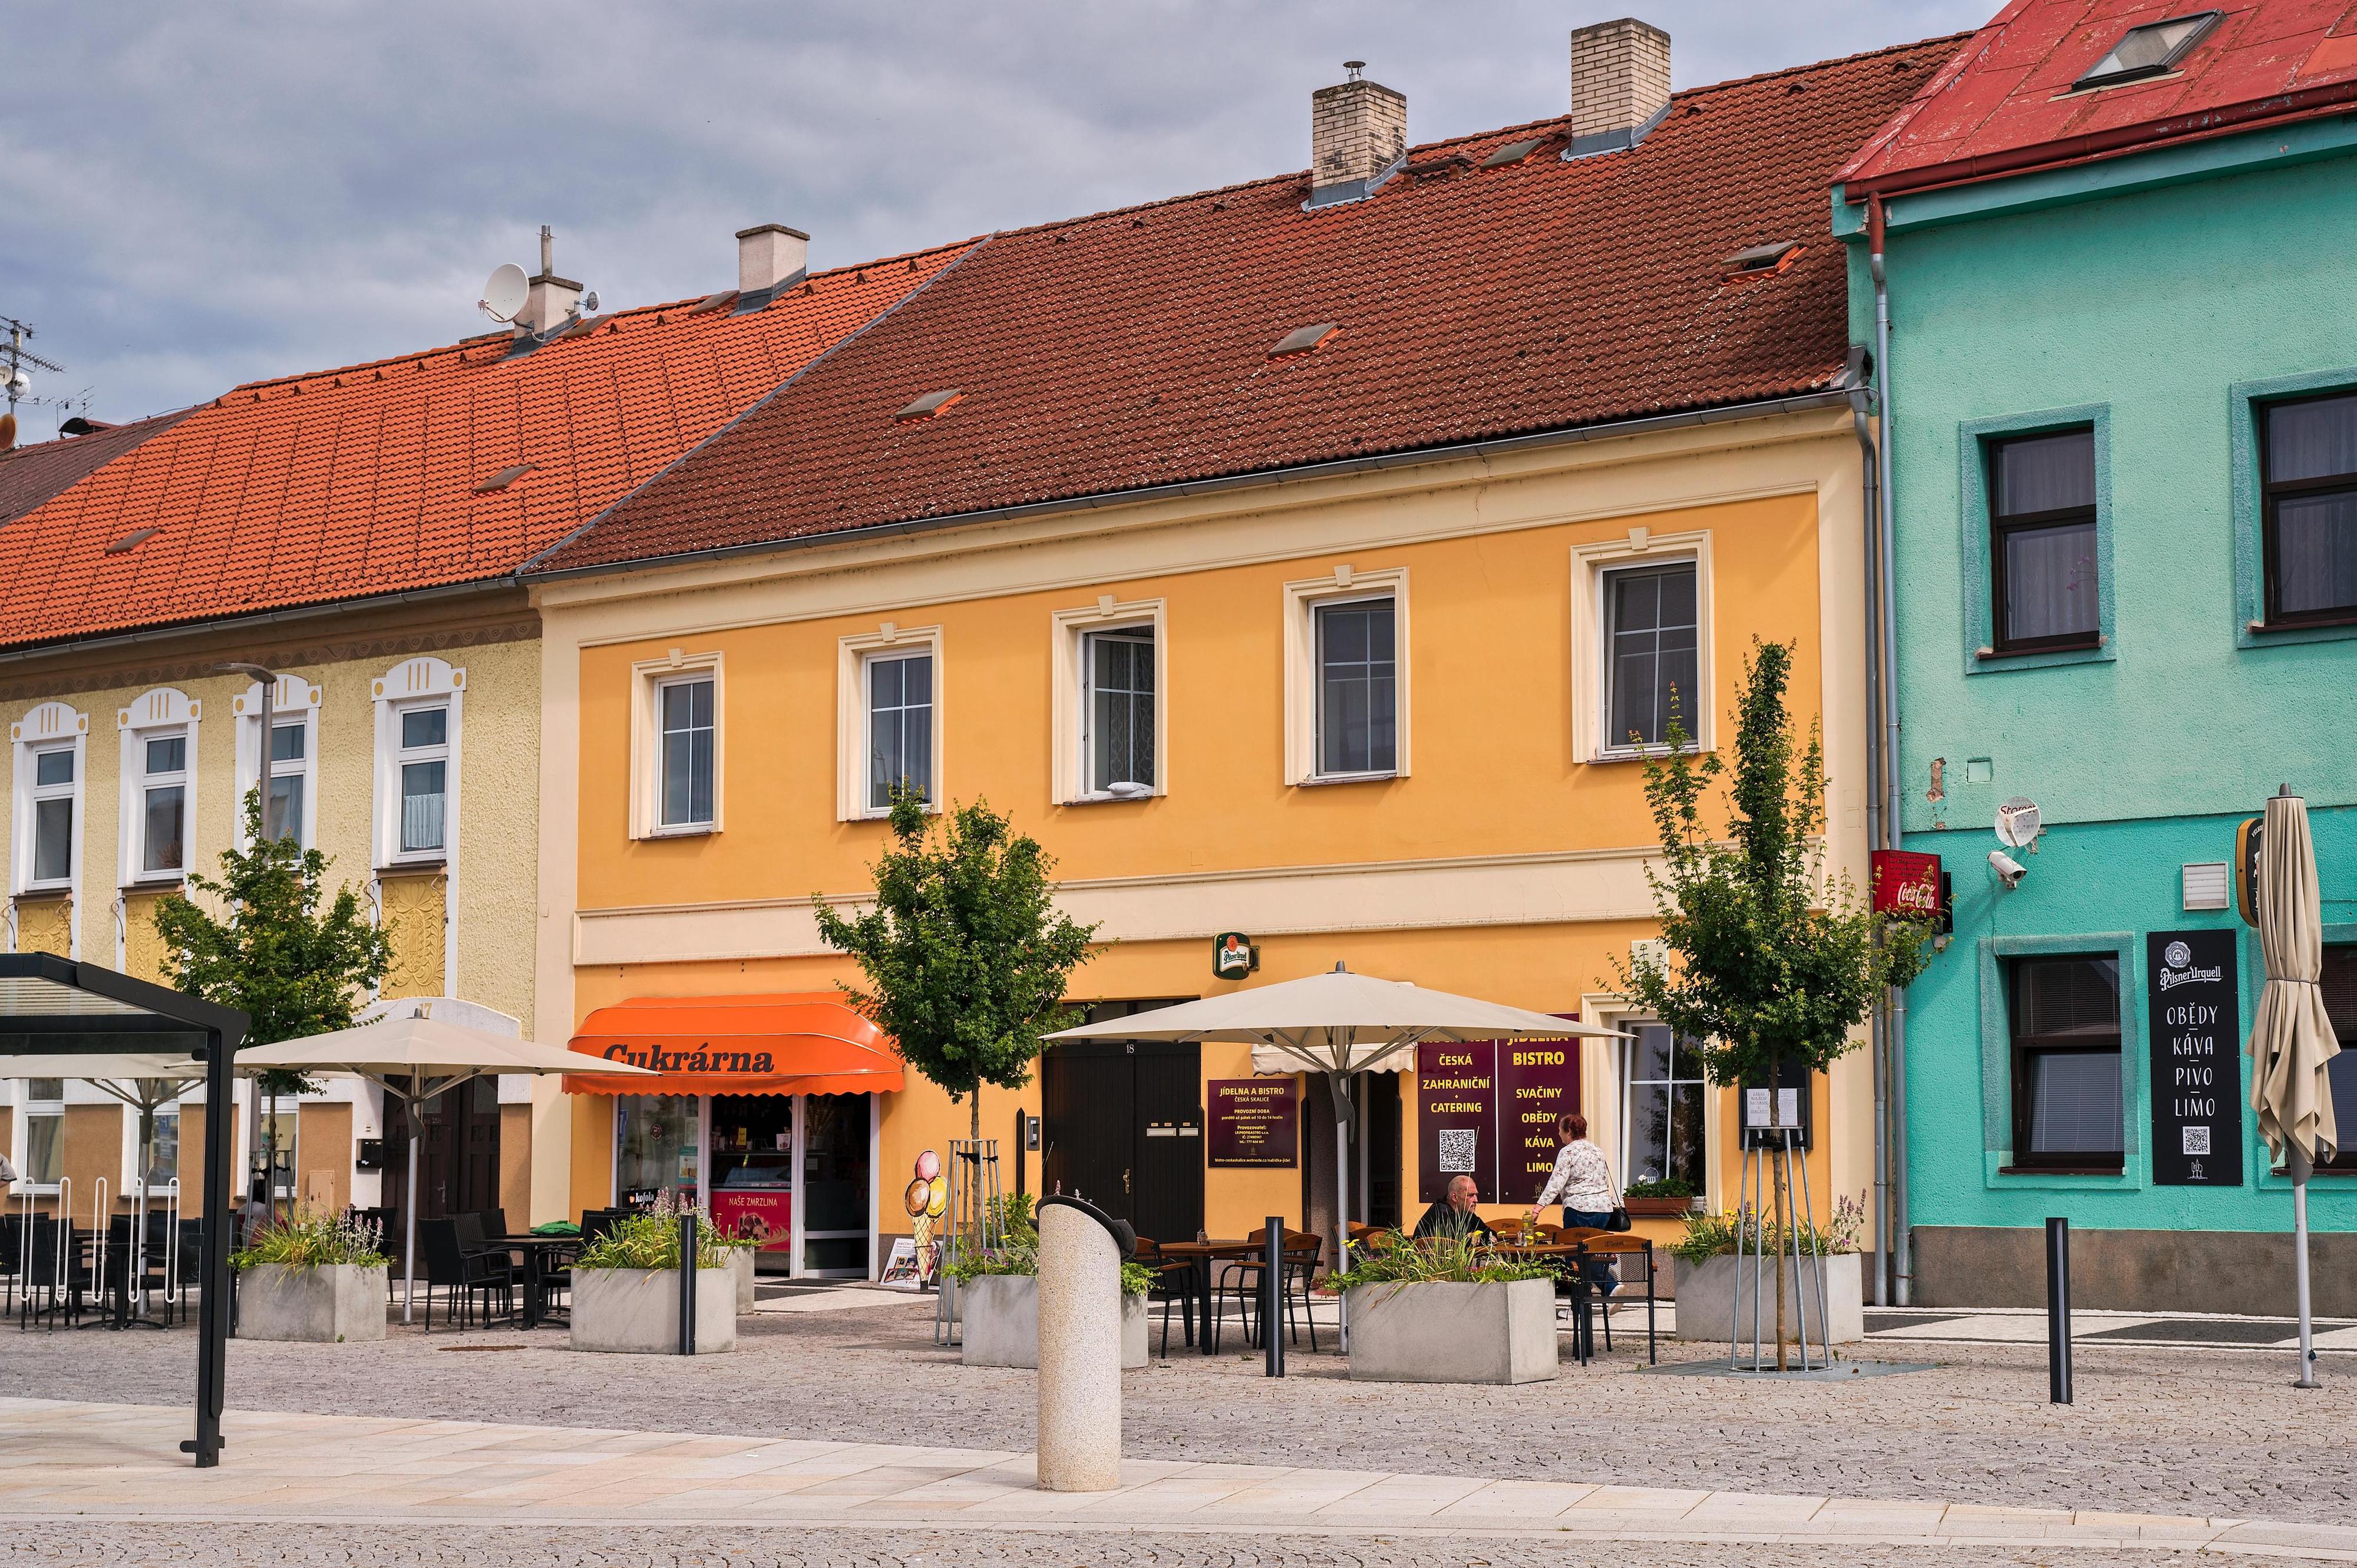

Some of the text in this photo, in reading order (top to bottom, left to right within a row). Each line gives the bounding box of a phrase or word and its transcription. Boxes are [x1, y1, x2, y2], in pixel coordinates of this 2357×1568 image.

[2160, 966, 2221, 991] Pilsner Urquell
[2167, 1002, 2218, 1025] OBĚDY
[1126, 1044, 1134, 1054] 18
[2173, 1032, 2213, 1055] KÁVA
[603, 1042, 775, 1073] Cukrárna
[1439, 1052, 1473, 1066] ČESKÁ
[1513, 1051, 1565, 1066] BISTRO
[1422, 1076, 1491, 1090] ZAHRANIČNÍ
[2176, 1067, 2213, 1086] PIVO
[1219, 1086, 1249, 1097] JÍDELNA
[1516, 1085, 1563, 1098] SVAČINY
[1431, 1102, 1482, 1113] CATERING
[2175, 1098, 2216, 1117] LIMO
[1521, 1110, 1557, 1123] OBĚDY
[1525, 1135, 1555, 1148] KÁVA
[1527, 1162, 1554, 1173] LIMO
[635, 1191, 654, 1205] kofola
[729, 1194, 778, 1207] NAŠE ZMRZLINA
